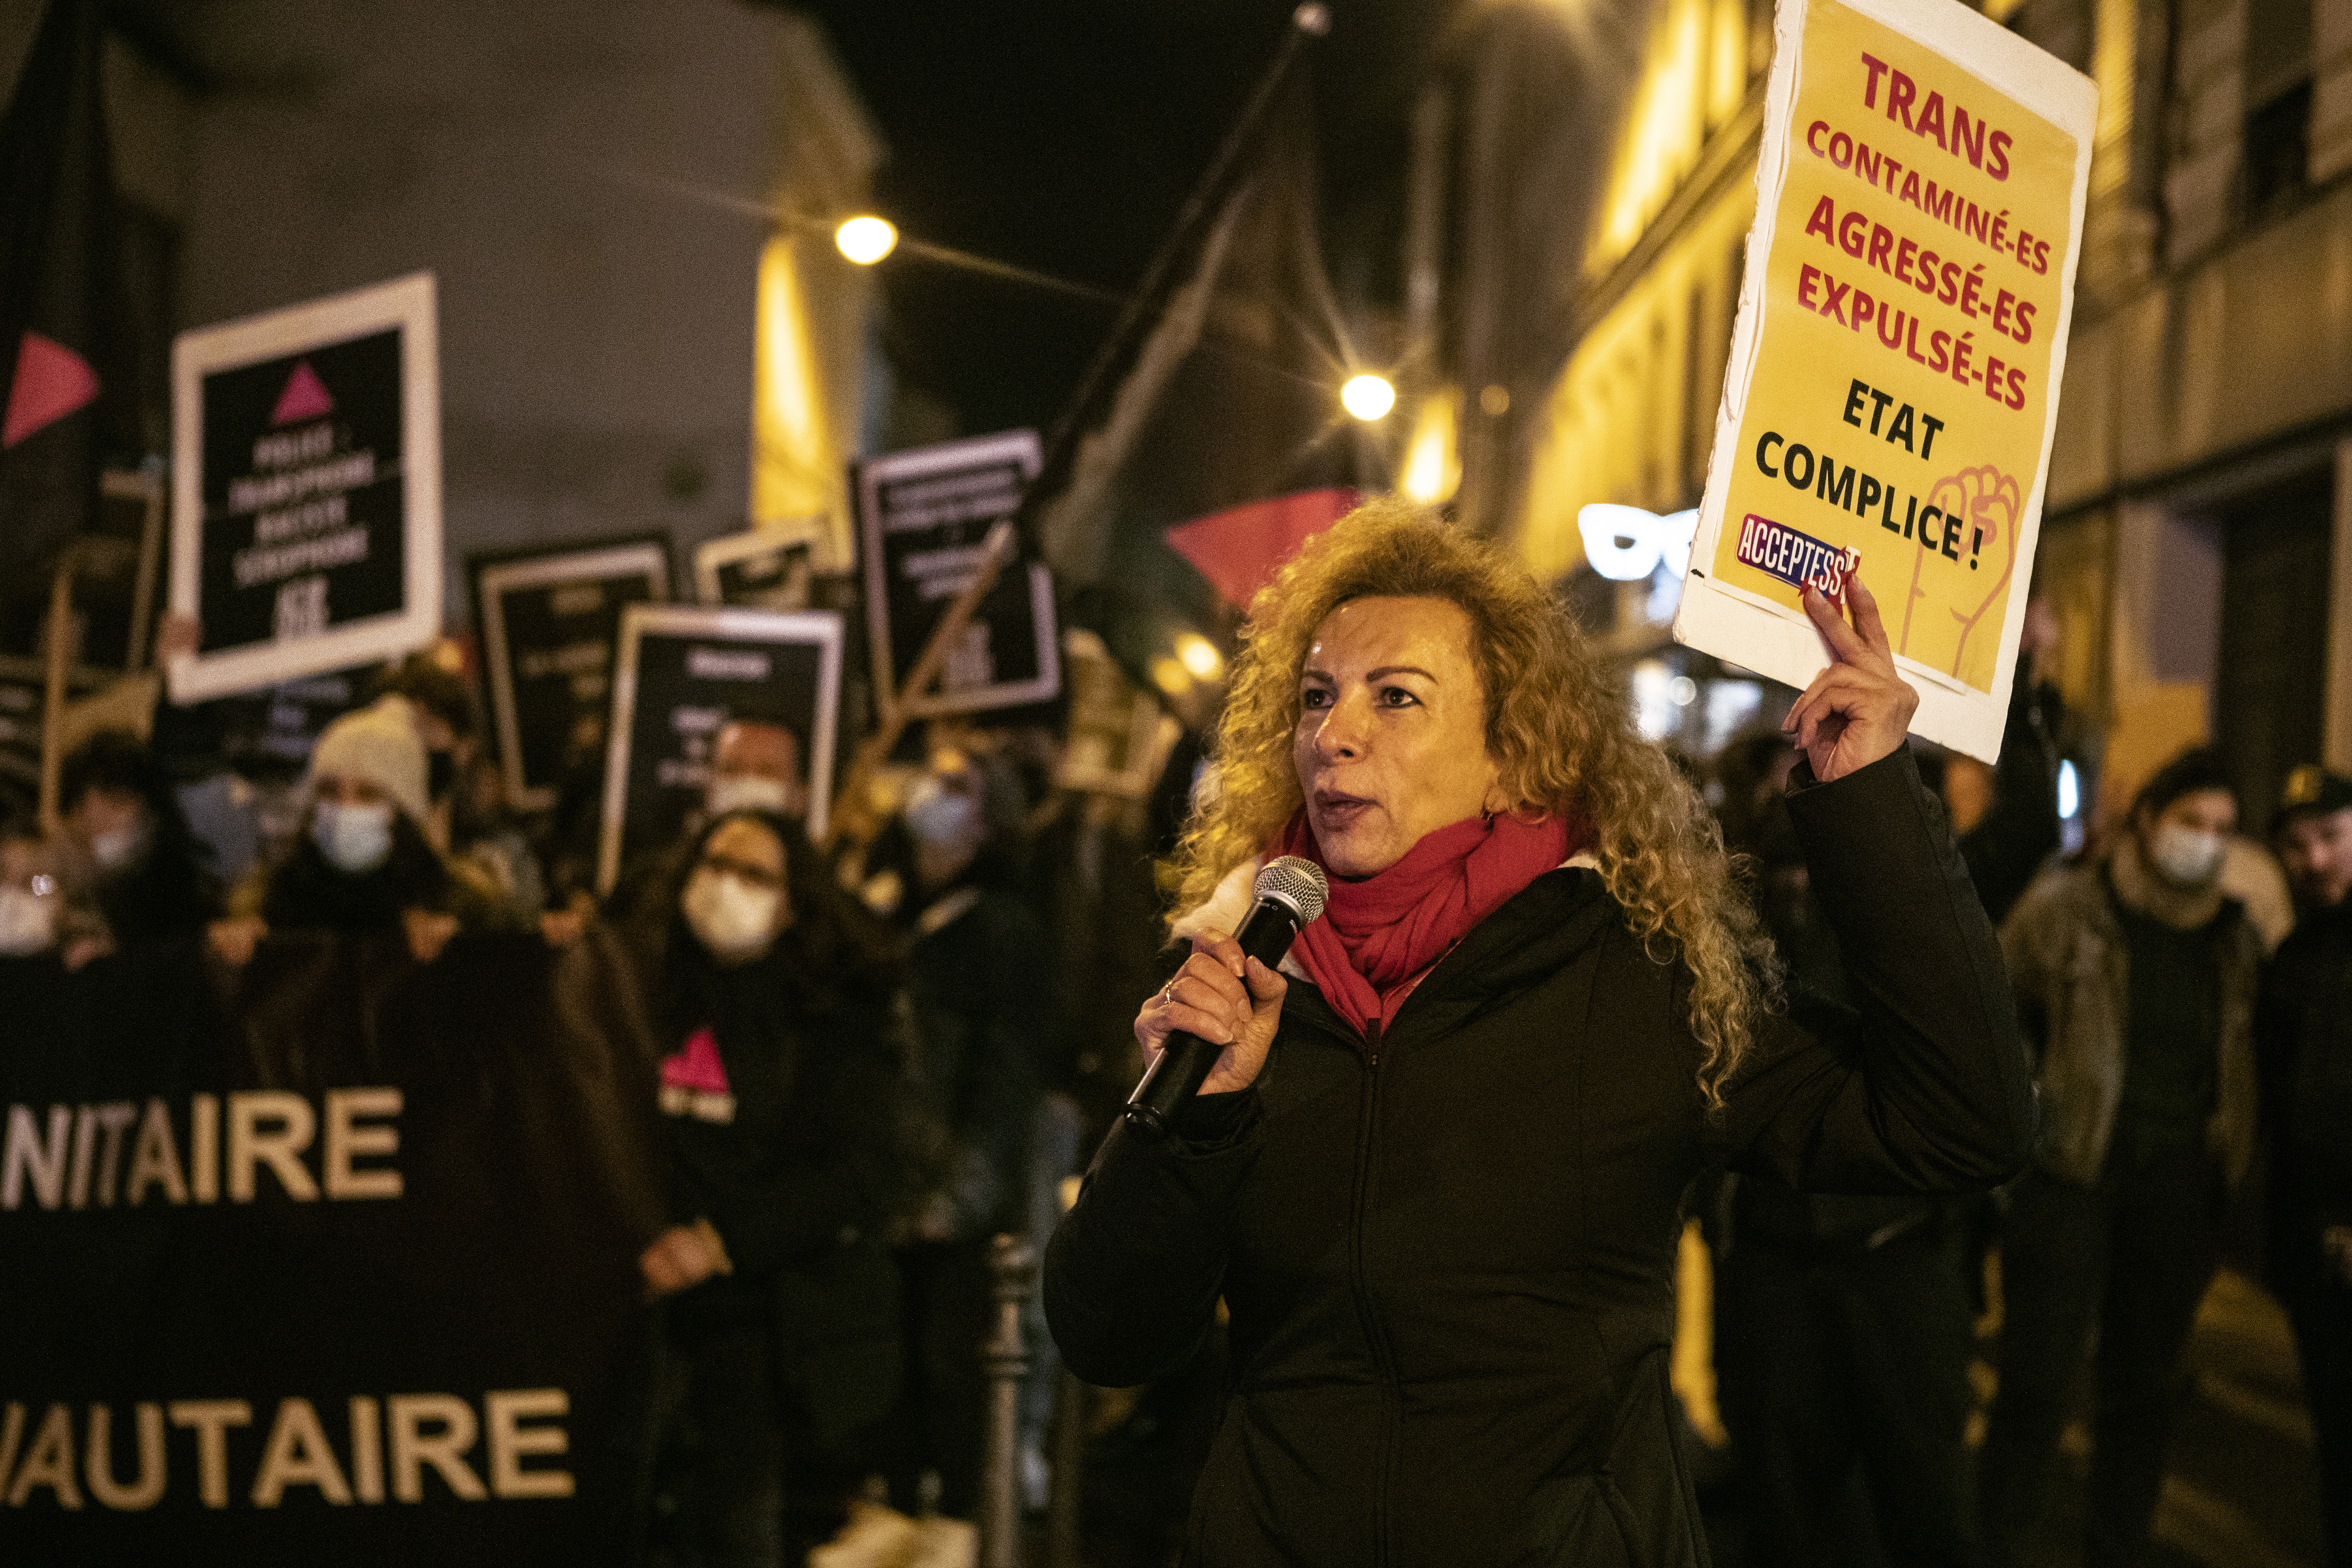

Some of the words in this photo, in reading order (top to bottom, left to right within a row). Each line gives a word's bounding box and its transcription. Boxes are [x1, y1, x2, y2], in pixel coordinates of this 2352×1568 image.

[1861, 51, 2013, 182] TRANS
[1805, 195, 2036, 344] AGRESSÉ-ES
[1807, 120, 2051, 275] CONTAMINÉ-ES
[1798, 263, 2026, 411] EXPULSÉ-ES
[1843, 378, 1944, 461] ETAT
